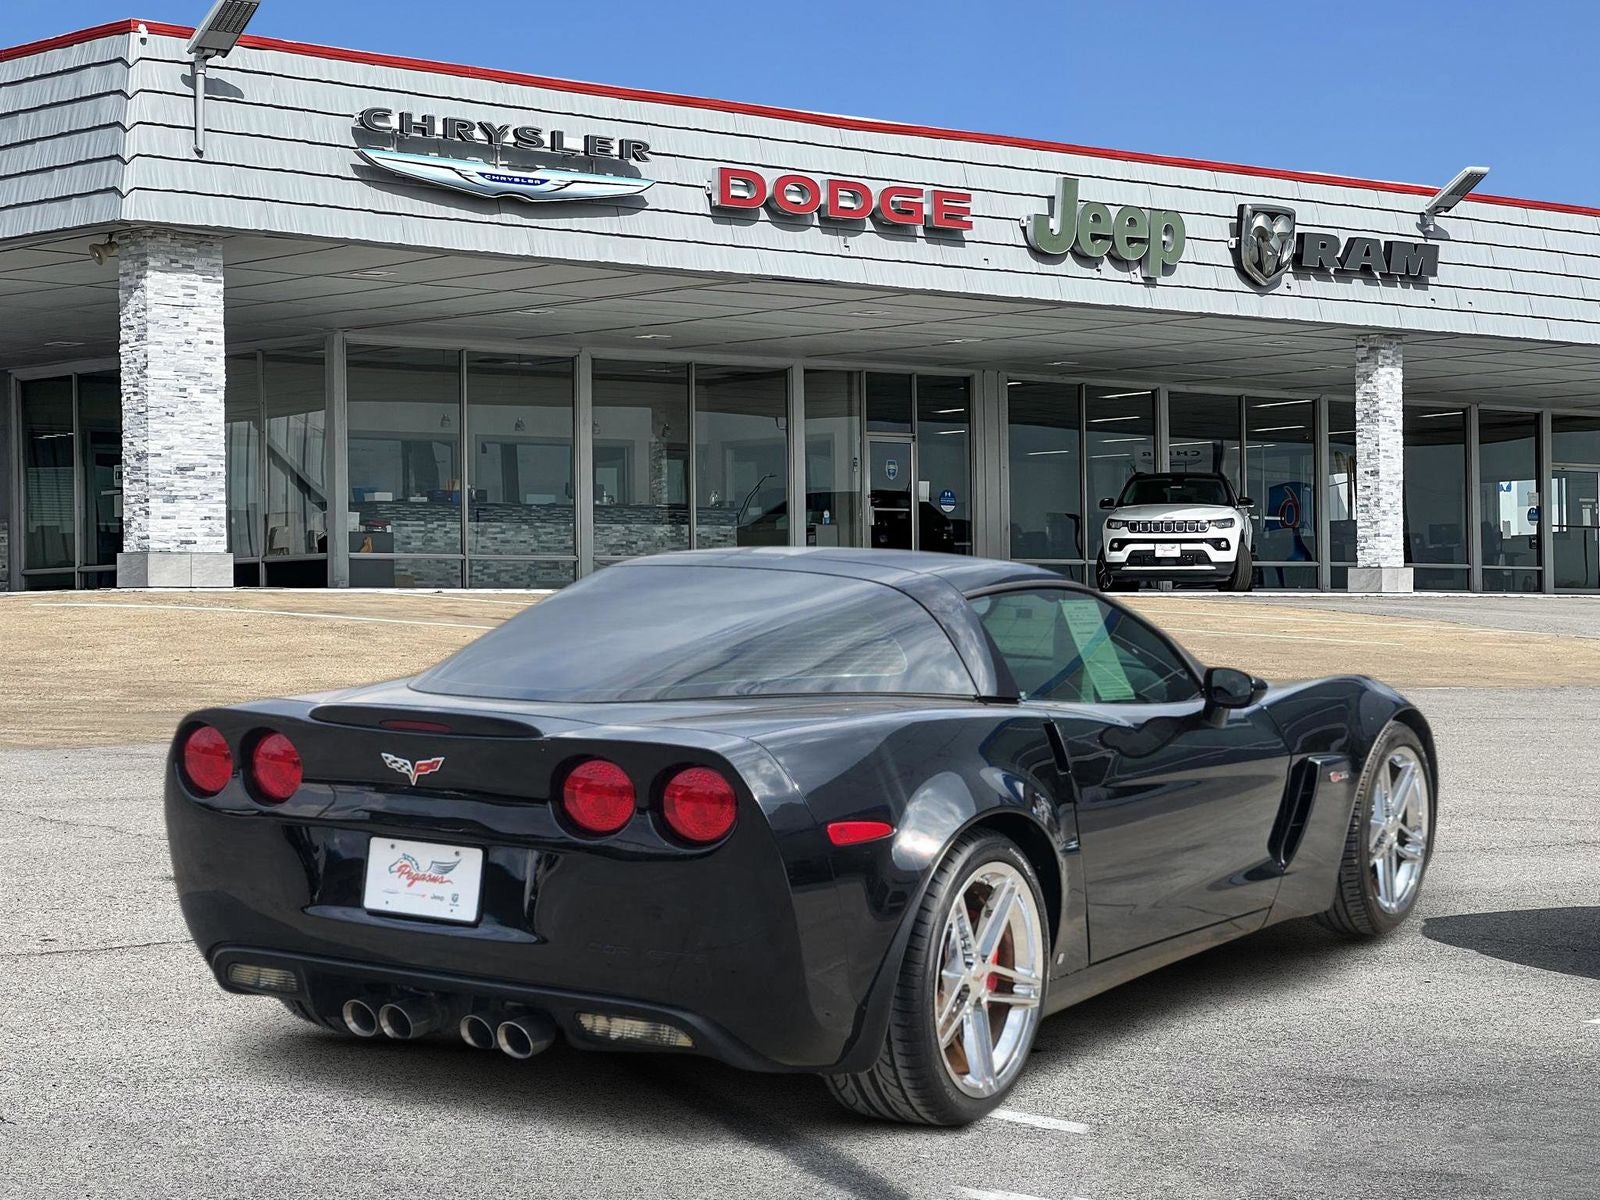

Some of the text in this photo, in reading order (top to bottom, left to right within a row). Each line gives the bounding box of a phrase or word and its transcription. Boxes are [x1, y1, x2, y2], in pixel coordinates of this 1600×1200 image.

[357, 106, 651, 162] CHRYSLER
[484, 174, 541, 185] CHRYSLER
[713, 166, 973, 231] DODGE
[1028, 176, 1186, 279] Jeep
[1298, 231, 1440, 278] RAM
[396, 863, 454, 889] Pegasus
